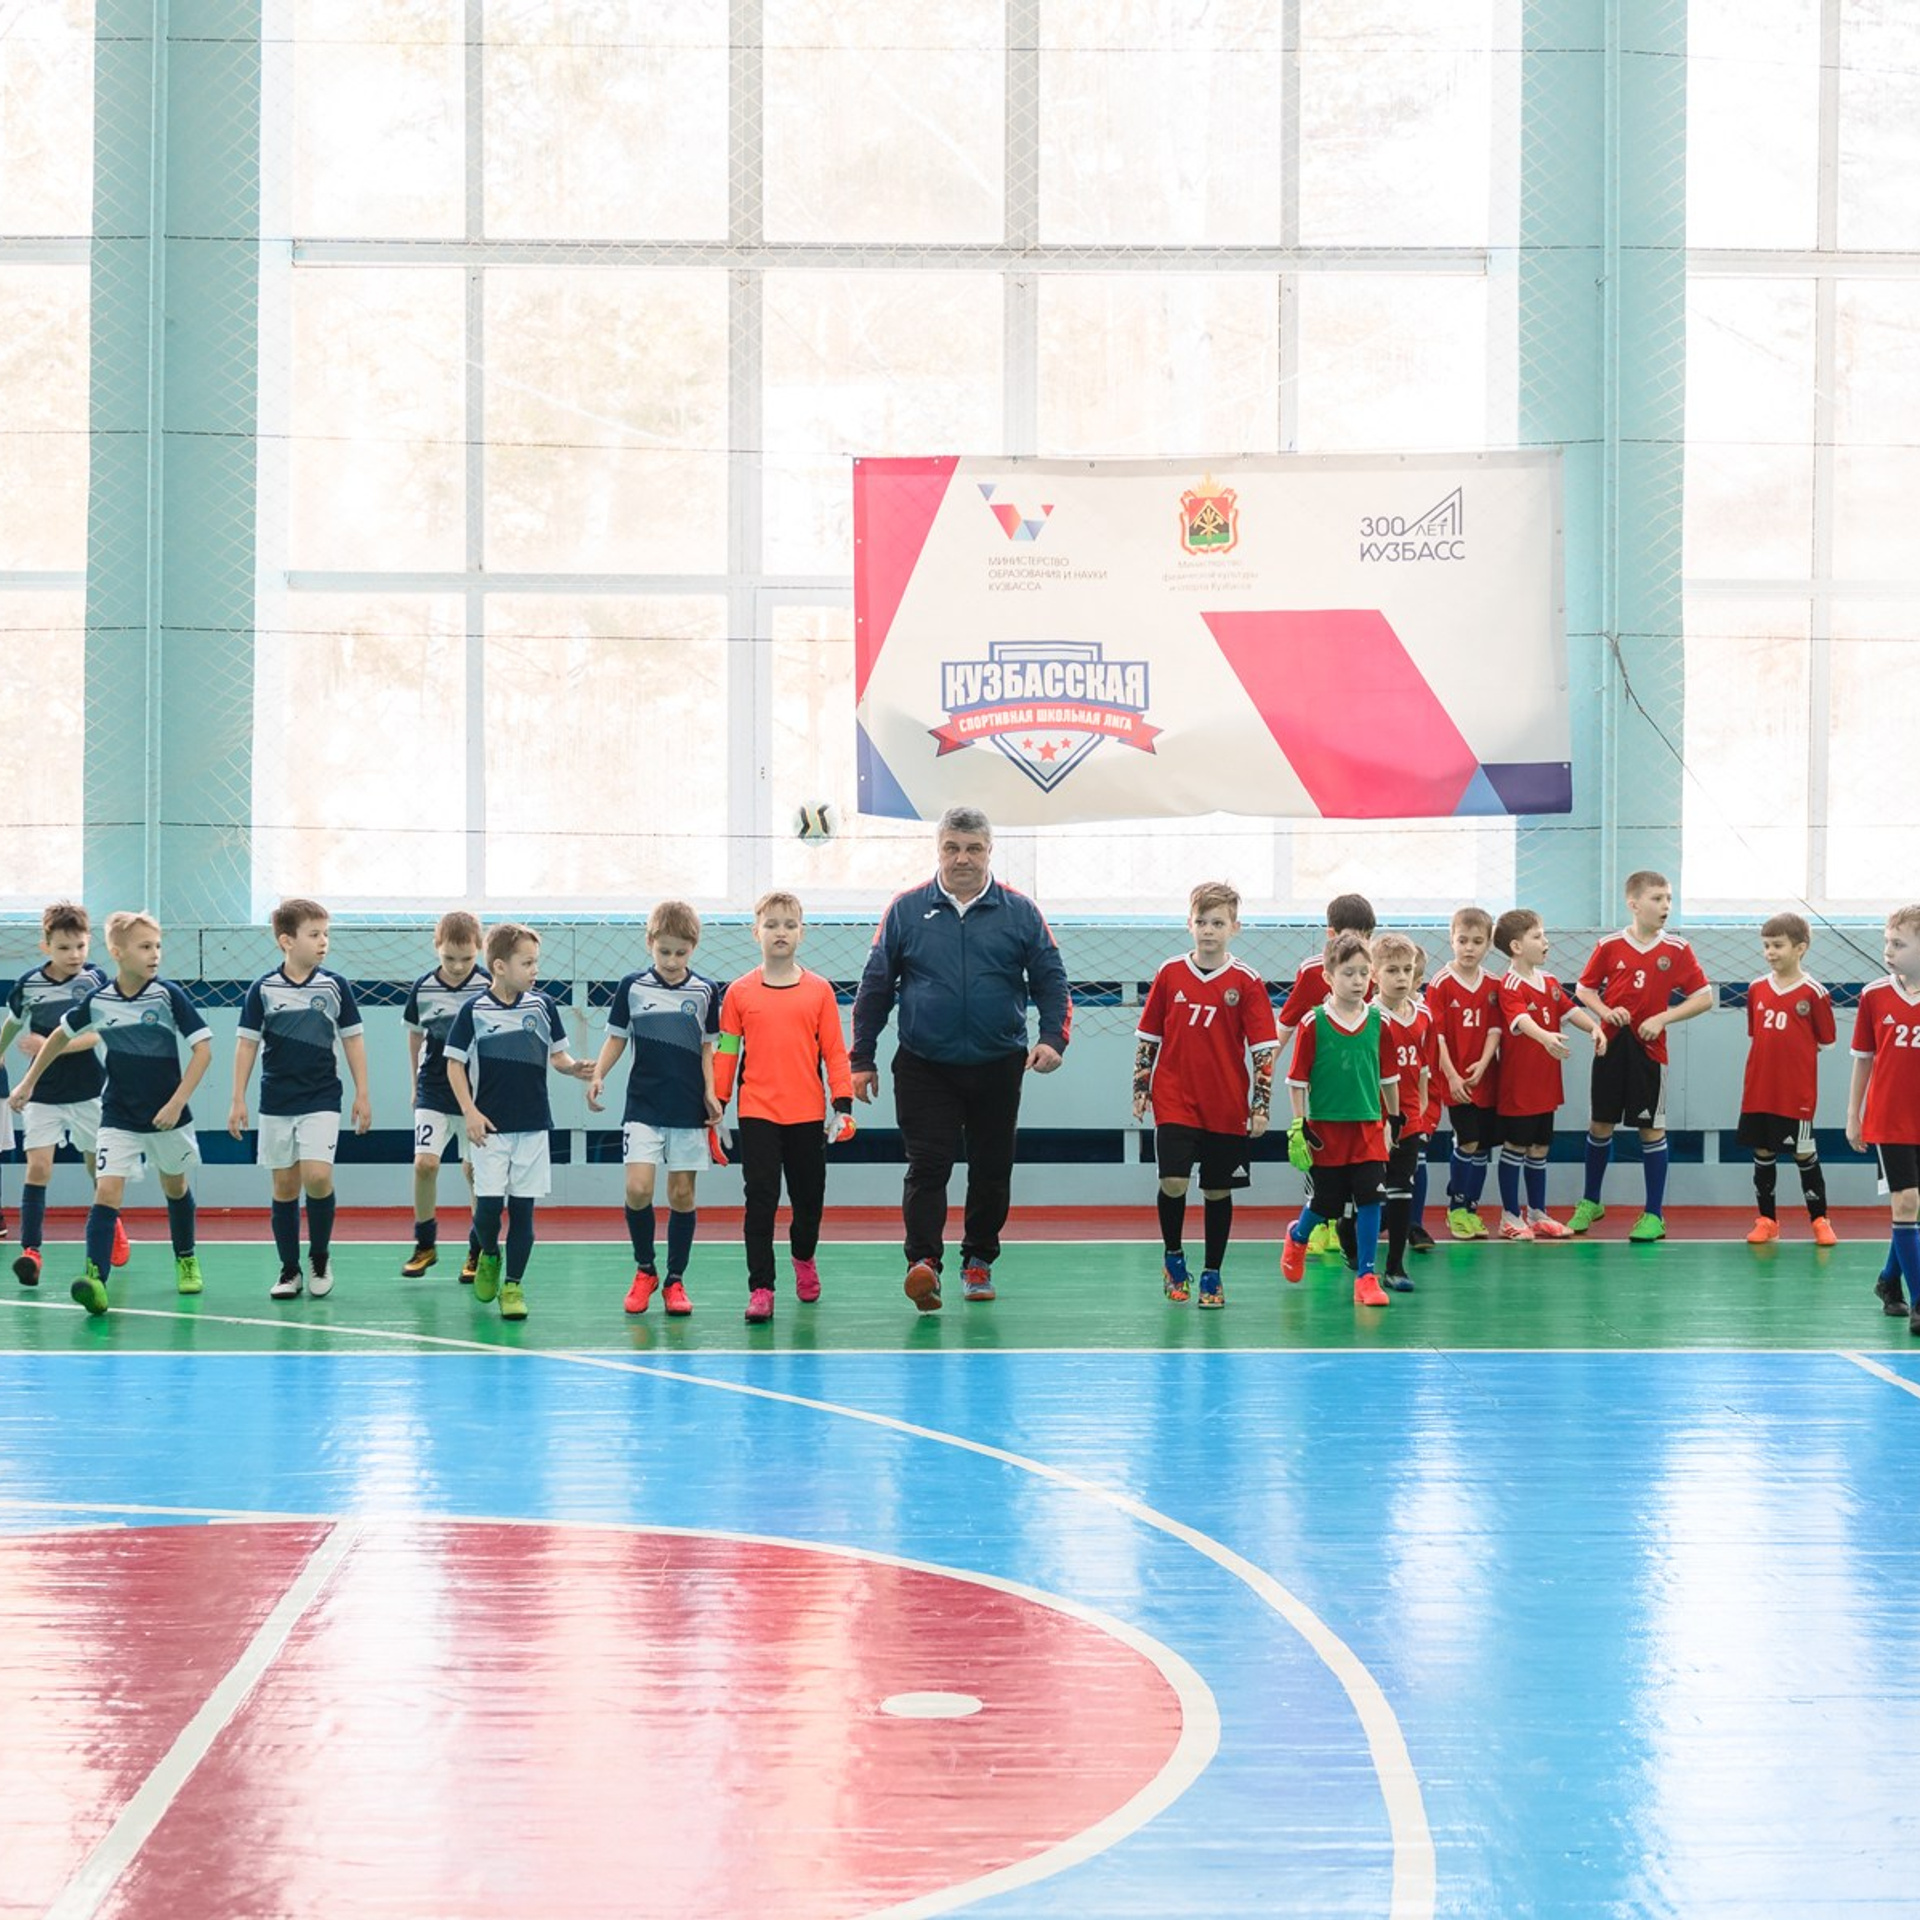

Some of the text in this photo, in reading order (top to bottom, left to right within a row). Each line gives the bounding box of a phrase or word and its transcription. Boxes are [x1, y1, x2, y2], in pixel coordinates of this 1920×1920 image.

[1360, 516, 1447, 537] 300 ЛЕТ
[988, 556, 1070, 567] МИНИСТЕРСТВО
[1360, 540, 1466, 562] КУЗБАСС
[988, 568, 1061, 579] ОБРАЗОВАНИЯ
[1074, 570, 1108, 579] НАУКИ
[988, 581, 1042, 591] КУЗБАССА
[945, 661, 1146, 709] КУЗБАССКАЯ
[958, 708, 1132, 733] СПОРТИВНАЯ ШКОЛЬНАЯ ЛИГА
[1633, 969, 1646, 989] 3
[1188, 1003, 1217, 1028] 77
[1462, 1008, 1480, 1027] 21
[1763, 1008, 1788, 1030] 20
[1894, 1023, 1920, 1048] 22
[1397, 1045, 1418, 1067] 32
[416, 1123, 434, 1147] 12
[97, 1147, 109, 1171] 5
